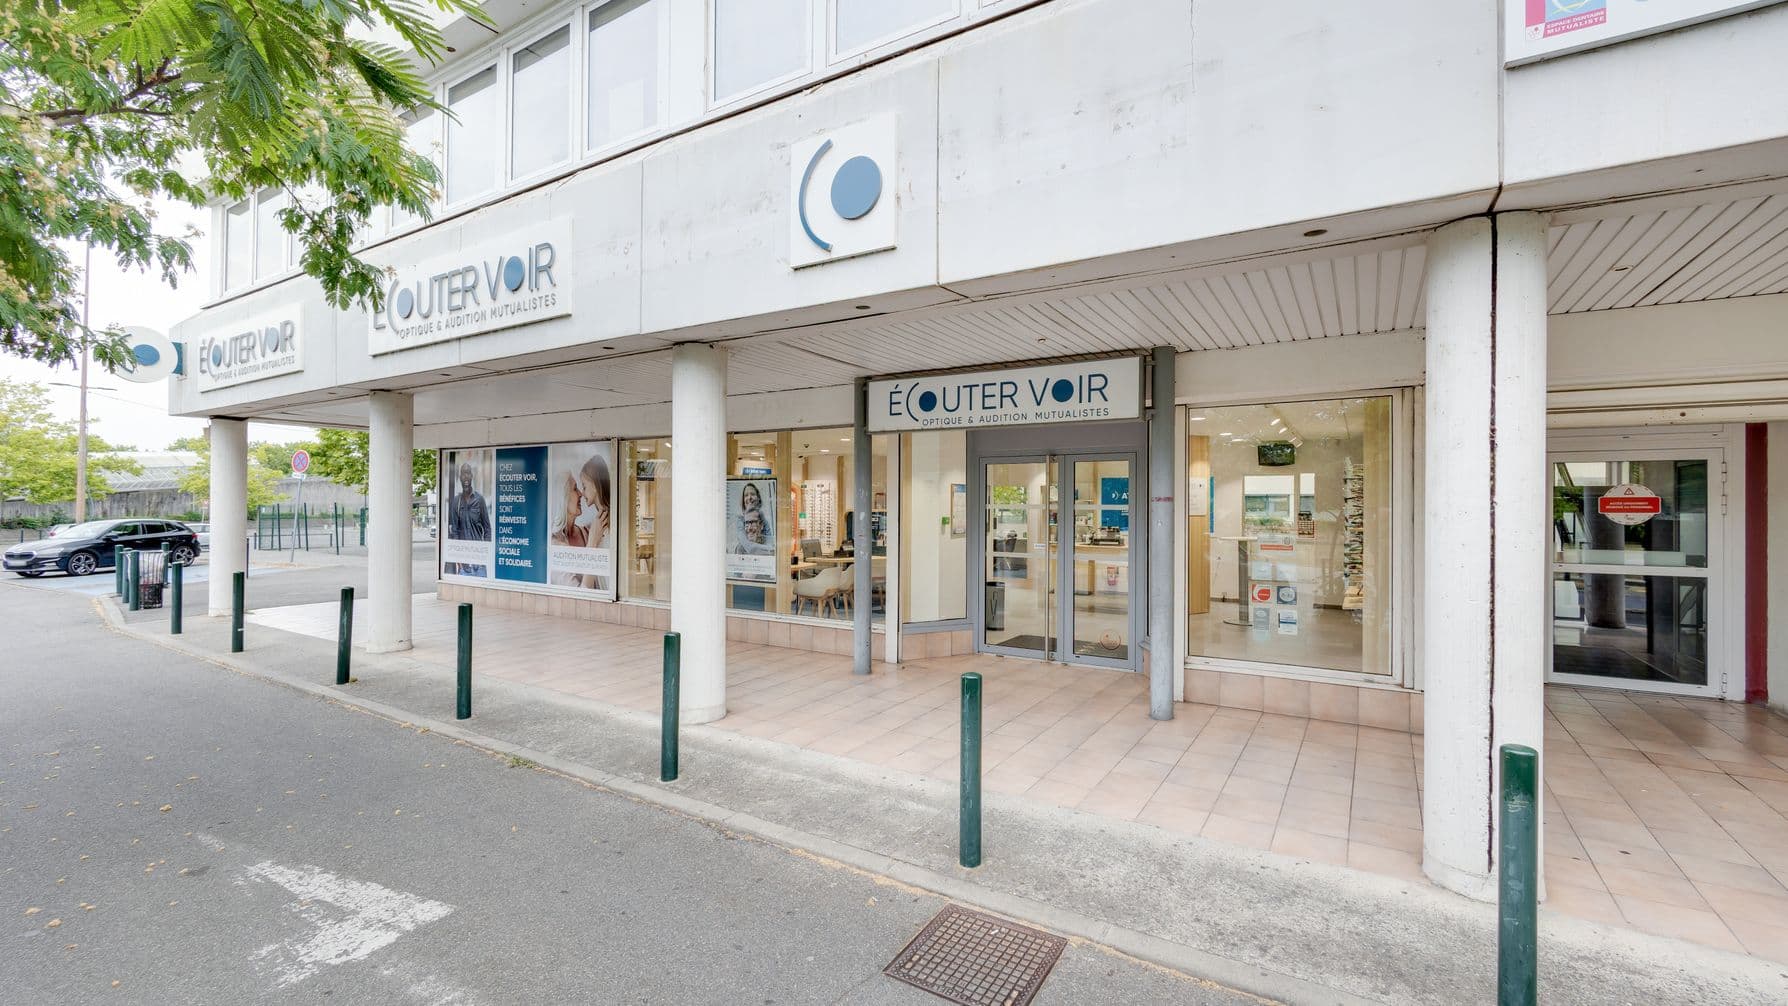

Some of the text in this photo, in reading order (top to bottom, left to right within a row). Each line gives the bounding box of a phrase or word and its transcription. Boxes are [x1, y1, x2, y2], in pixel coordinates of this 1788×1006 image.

[1546, 15, 1605, 35] MUTUALISTE
[484, 242, 556, 300] VOIR
[400, 322, 434, 340] OPTIQUE
[445, 311, 487, 329] AUDITION
[490, 292, 557, 317] MUTUALISTES
[199, 319, 295, 378] ÉCOUTER VOIR
[889, 373, 1109, 422] ÉCOUTER VOIR
[922, 407, 1110, 426] OPTIQUE & AUDITION MUTUALISTES
